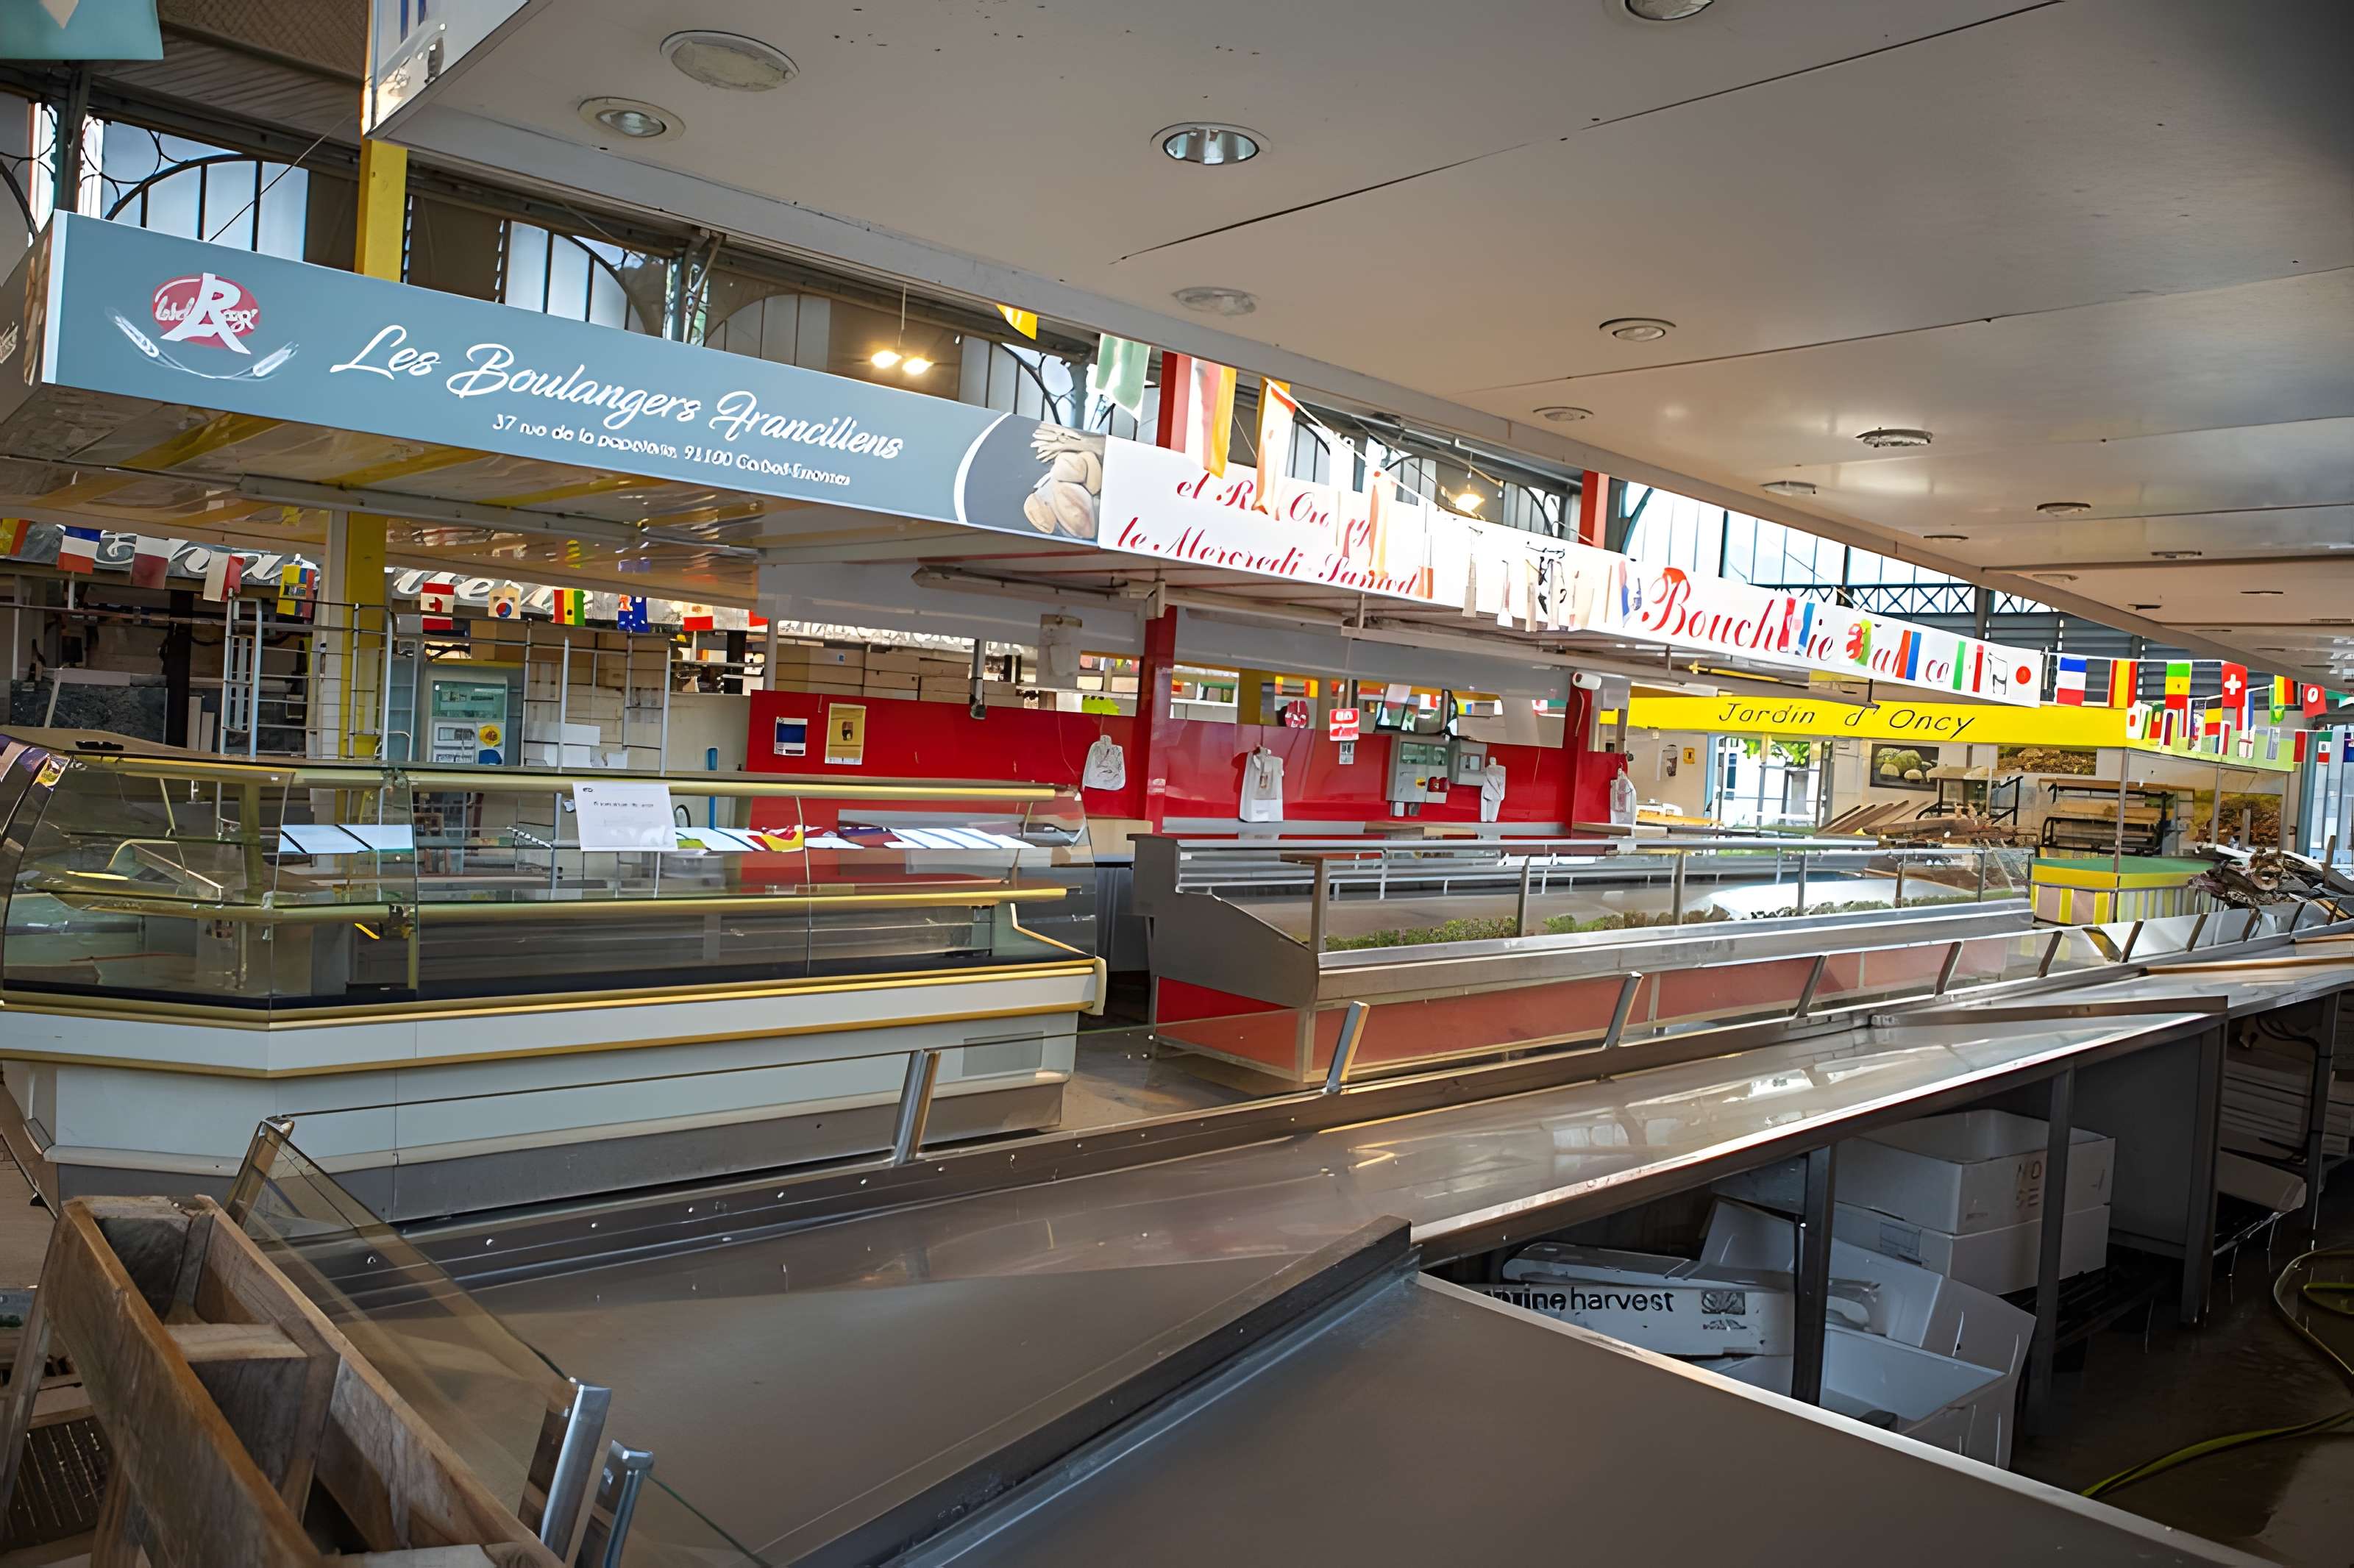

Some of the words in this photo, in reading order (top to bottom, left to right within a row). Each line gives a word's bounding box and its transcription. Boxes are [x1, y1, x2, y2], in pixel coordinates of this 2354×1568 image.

[330, 324, 441, 380] Les
[446, 343, 702, 431] Boulangers
[708, 390, 905, 460] Franciliens
[1718, 702, 1816, 724] Jardin
[1888, 708, 1976, 741] Oncy
